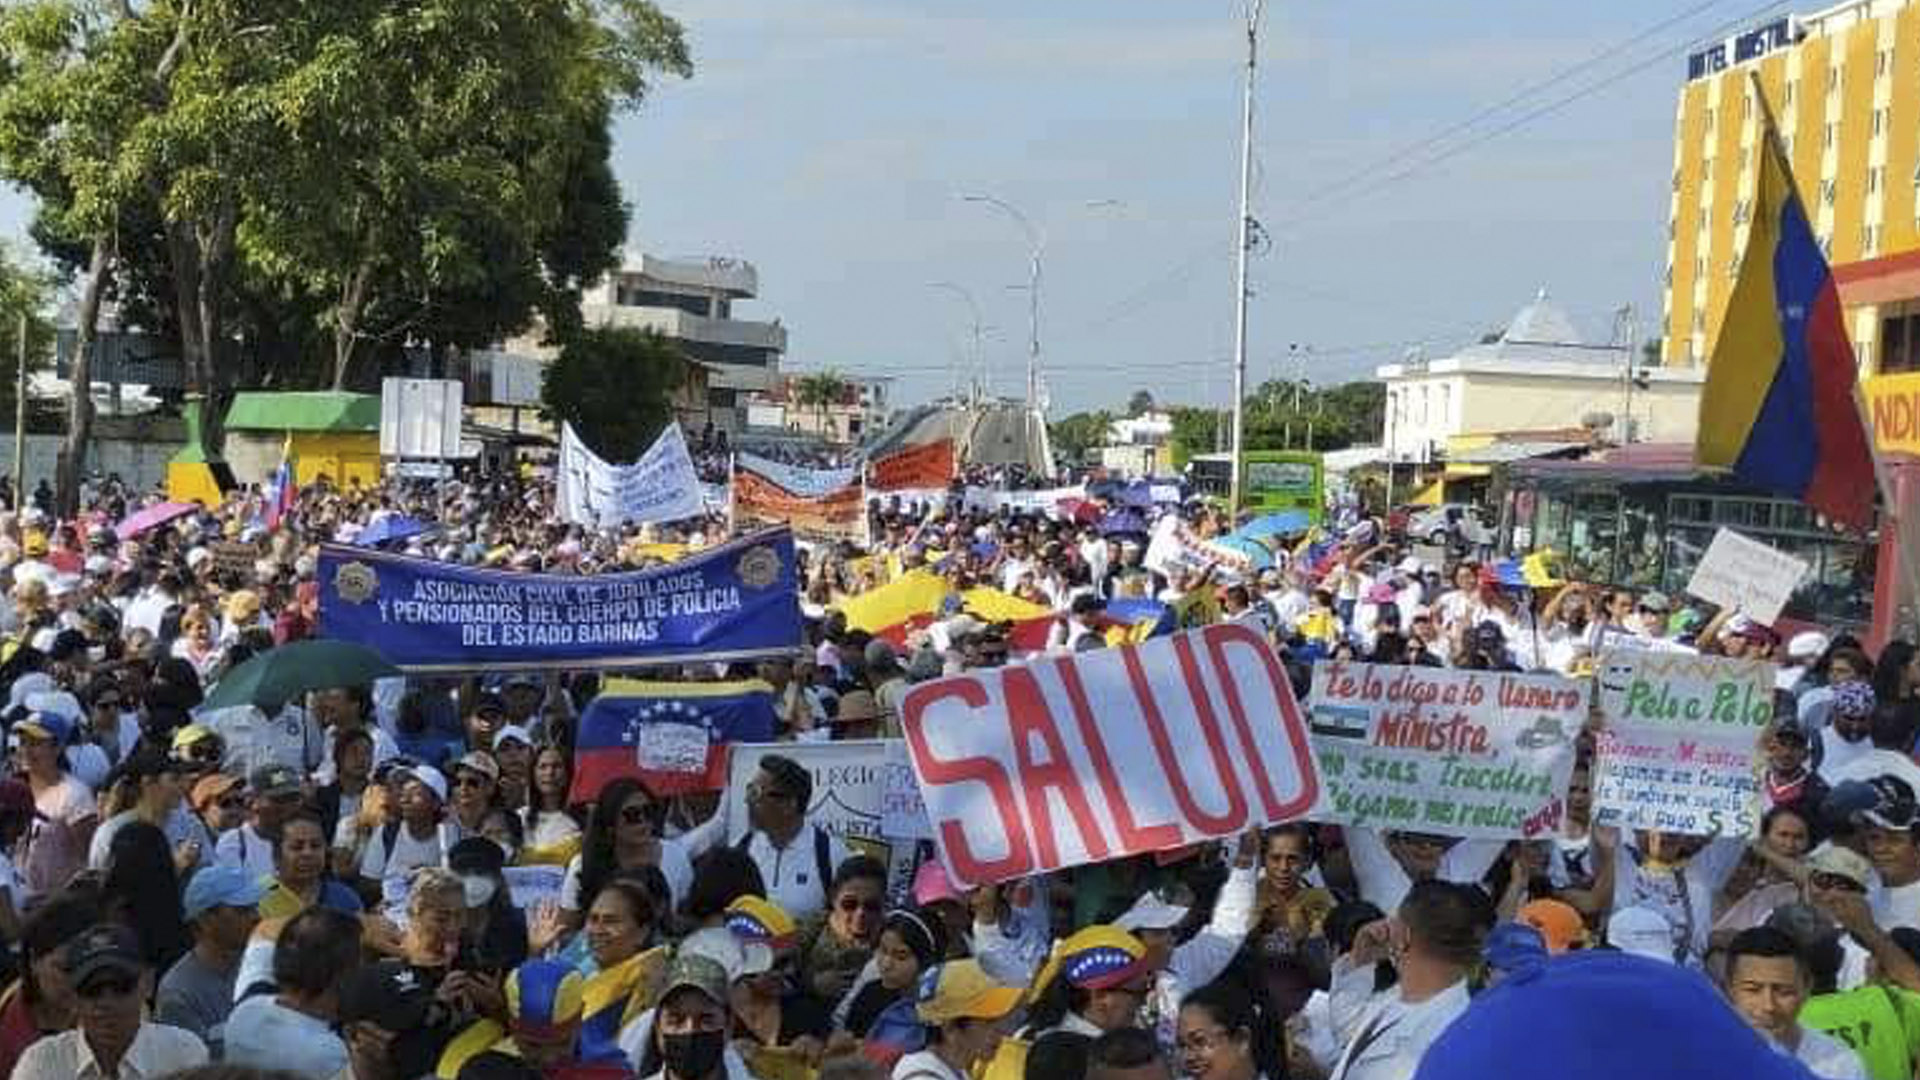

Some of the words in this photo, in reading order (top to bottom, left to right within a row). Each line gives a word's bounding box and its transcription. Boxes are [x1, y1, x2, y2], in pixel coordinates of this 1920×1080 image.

[525, 582, 570, 605] CIVIL
[577, 583, 604, 604] DE
[377, 599, 389, 624] Y
[393, 600, 523, 625] PENSIONADOS
[527, 602, 563, 625] DEL
[567, 600, 639, 625] CUERPO
[644, 596, 668, 619] DE
[462, 624, 498, 646] DEL
[501, 623, 573, 646] ESTADO
[577, 620, 659, 645] BARINAS
[903, 623, 1320, 887] SALUD
